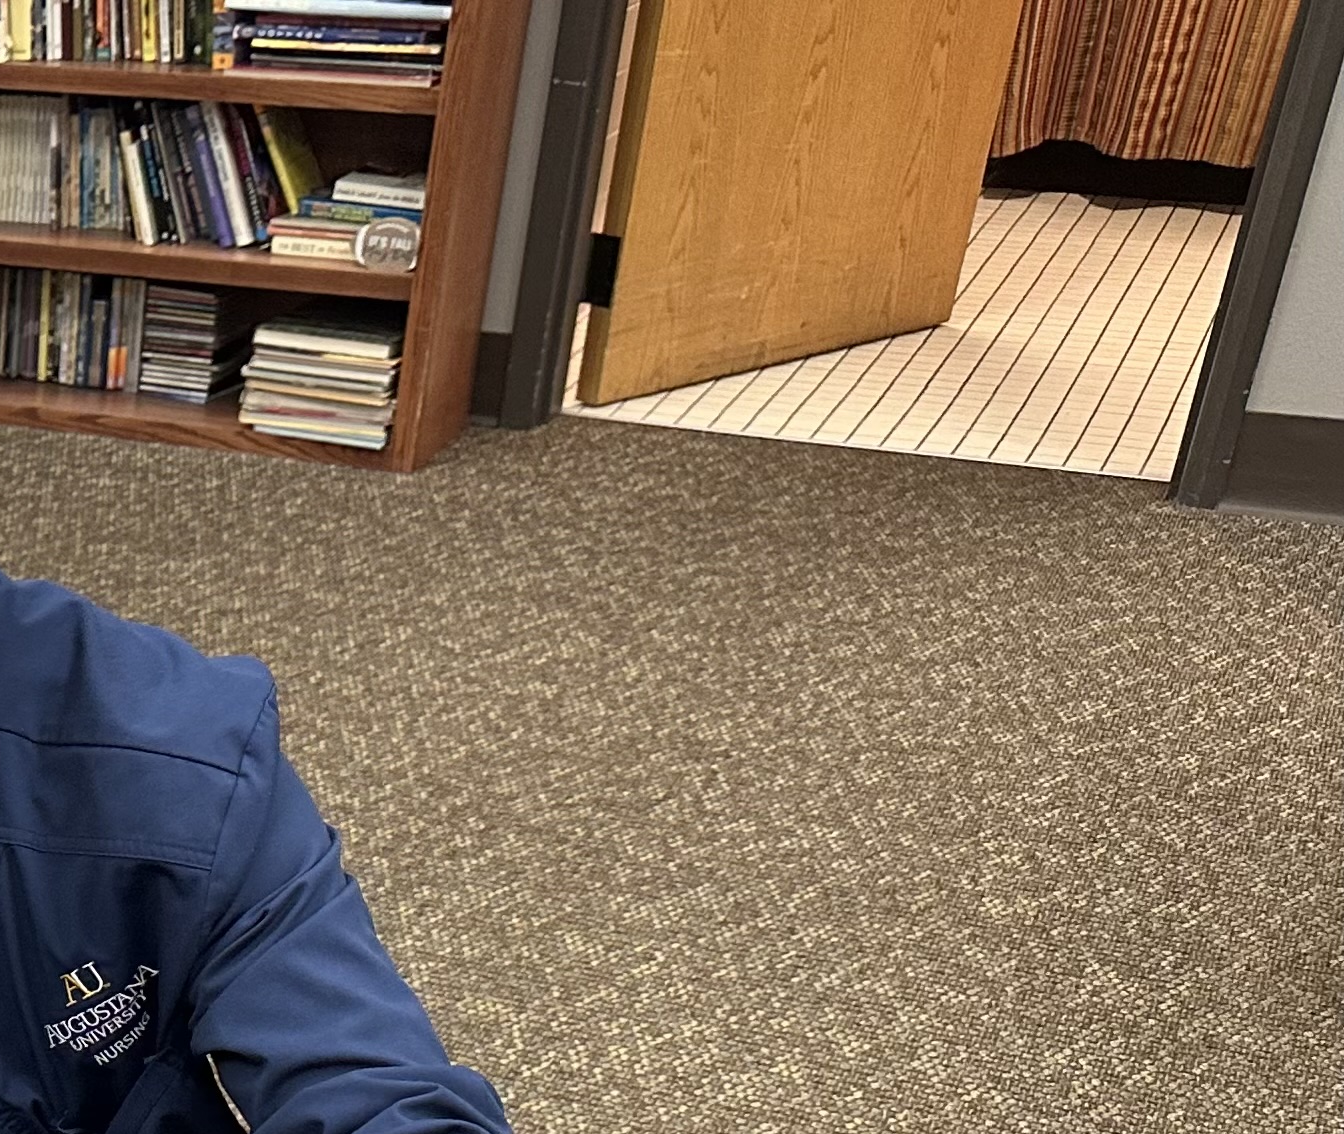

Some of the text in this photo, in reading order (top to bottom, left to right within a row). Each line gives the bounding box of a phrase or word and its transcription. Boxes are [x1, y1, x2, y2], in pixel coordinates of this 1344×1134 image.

[44, 964, 160, 1049] AUGUSTANA
[60, 961, 104, 1007] AU
[69, 990, 147, 1051] UNIVERSITY
[94, 1011, 150, 1066] NURSING
